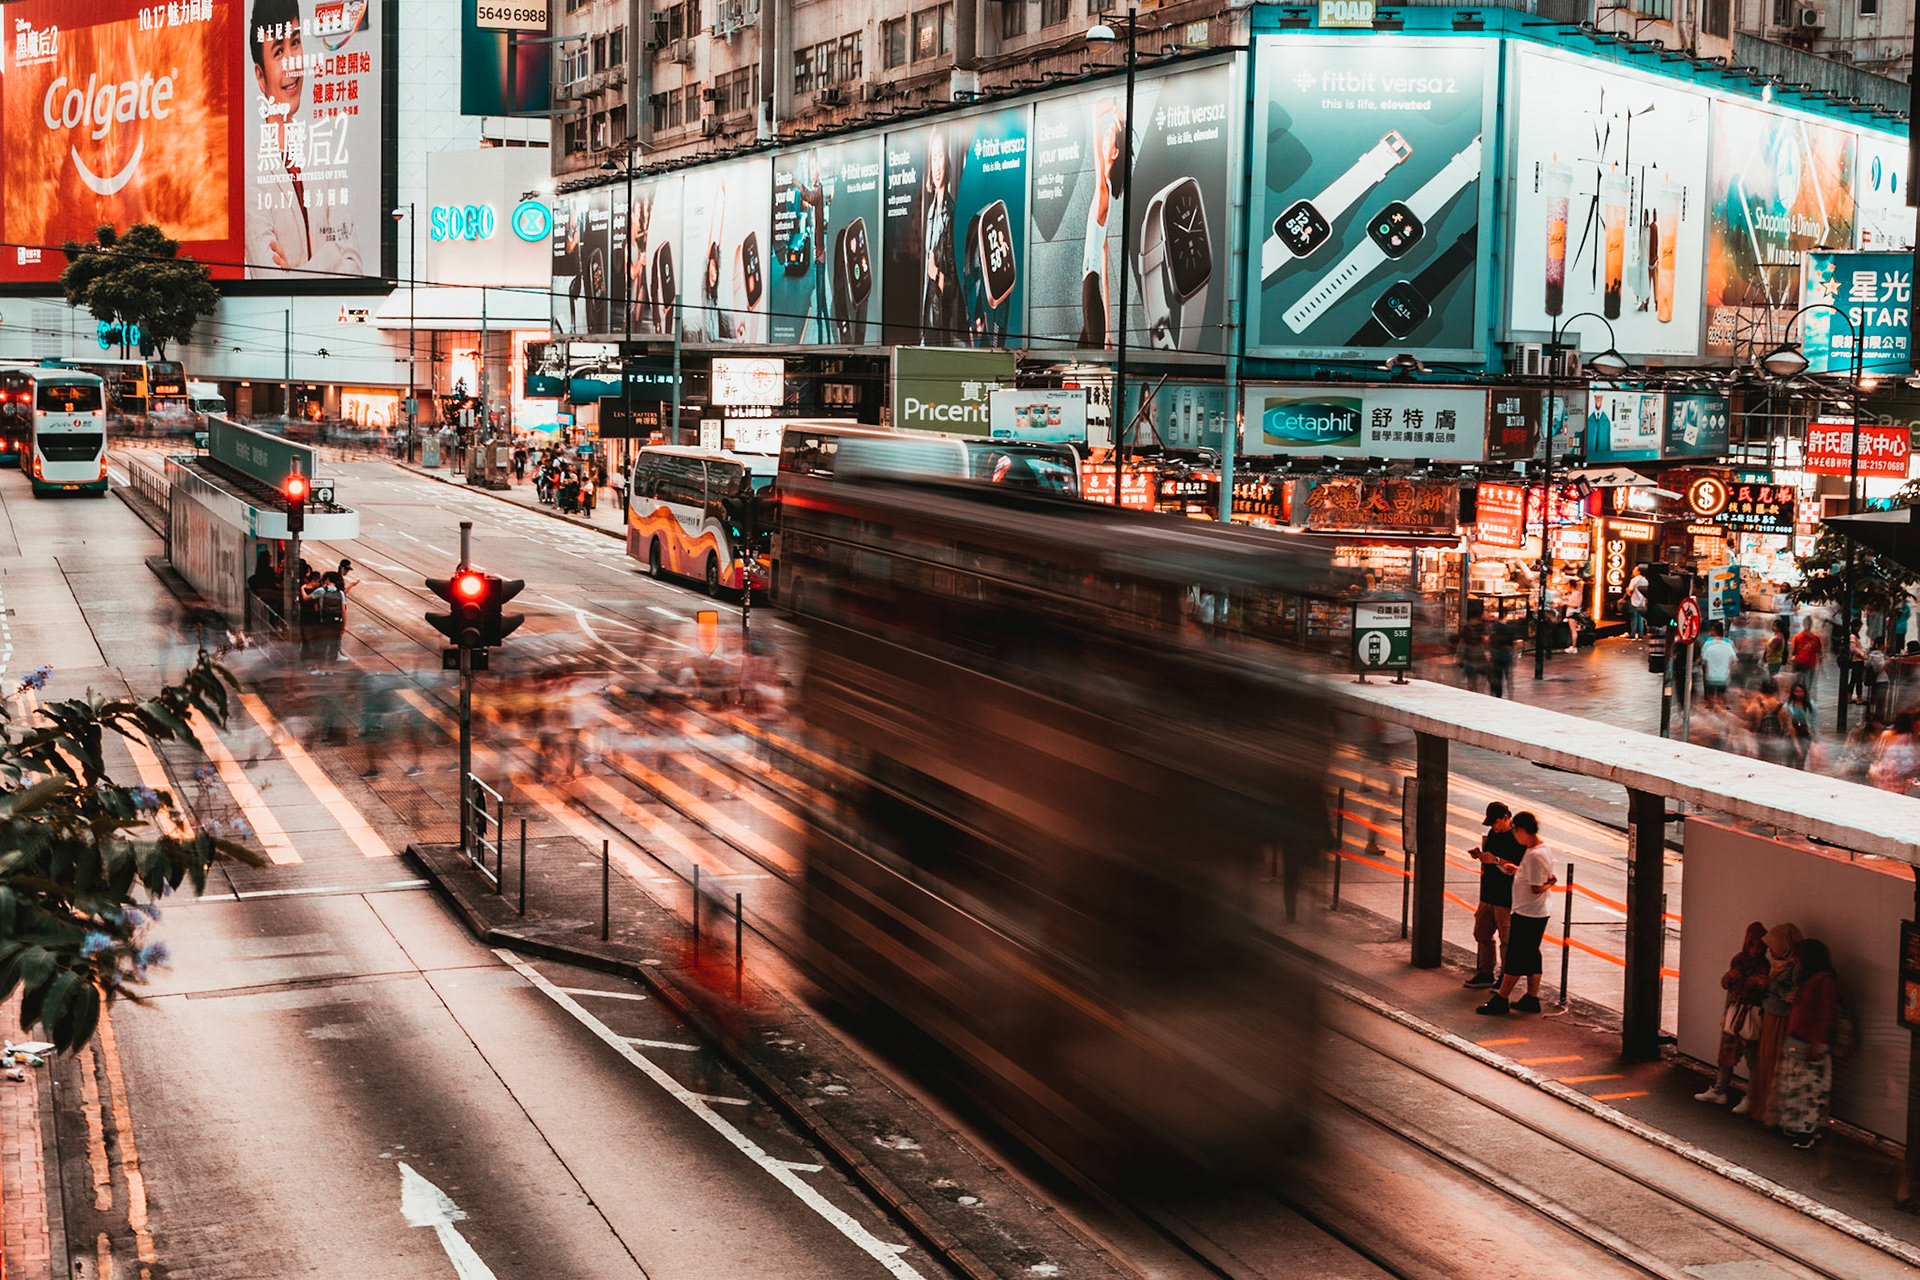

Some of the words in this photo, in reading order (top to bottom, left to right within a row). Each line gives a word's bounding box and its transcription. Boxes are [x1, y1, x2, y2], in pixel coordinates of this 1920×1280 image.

[138, 5, 165, 31] 10.17
[478, 7, 511, 20] 5649
[514, 9, 545, 22] 6988
[1321, 1, 1373, 21] POAD
[1187, 22, 1208, 44] POAD
[313, 80, 359, 104] 健康升級
[1321, 71, 1376, 92] fitbit
[44, 72, 173, 140] Colgate
[256, 95, 292, 123] Disney
[1321, 99, 1343, 109] this
[1345, 99, 1355, 109] is
[1380, 99, 1431, 110] elevated
[1167, 107, 1190, 128] fitbit
[256, 112, 349, 172] 黑魔后2
[1039, 122, 1068, 141] Elevate
[1038, 148, 1057, 167] your
[1058, 142, 1080, 161] week
[257, 193, 294, 210] 10.17
[431, 205, 494, 242] SOGO
[1755, 206, 1791, 239] Shopping
[1798, 213, 1821, 244] Dining
[1849, 270, 1911, 302] 星光
[1849, 307, 1909, 327] STAR
[64, 402, 75, 412] 23
[905, 398, 988, 423] Pricerit
[1272, 411, 1353, 436] Cetaphil
[1371, 408, 1456, 430] 舒特膚
[1609, 522, 1649, 531] WESTERN
[1620, 530, 1649, 539] UNION
[1687, 525, 1722, 536] CHANGE
